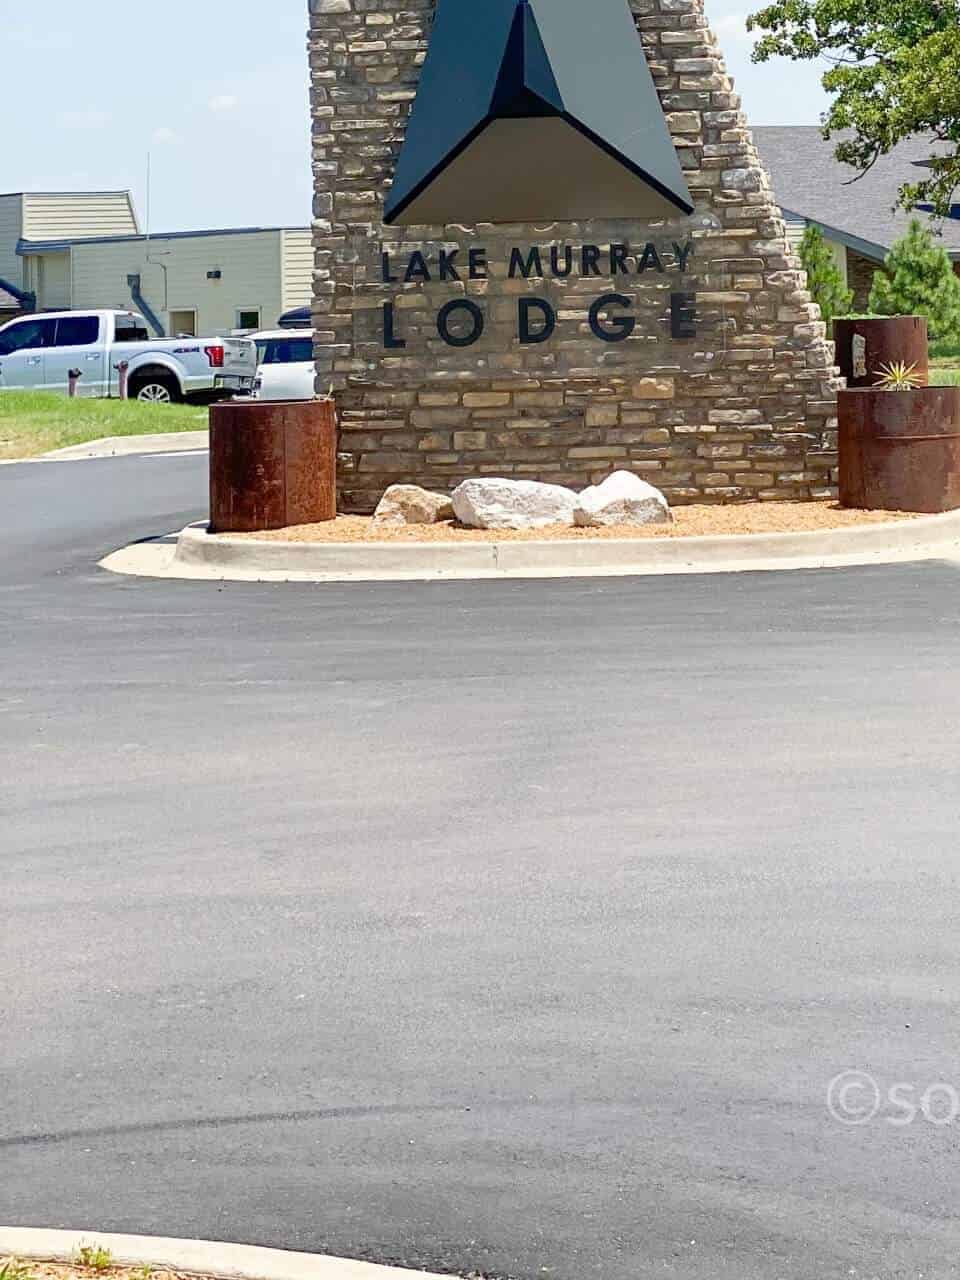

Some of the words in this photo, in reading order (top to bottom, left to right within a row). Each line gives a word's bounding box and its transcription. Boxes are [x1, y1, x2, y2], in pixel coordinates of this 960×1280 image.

[381, 248, 488, 283] LAKE
[508, 241, 693, 279] MURRAY
[383, 292, 697, 349] LODGE
